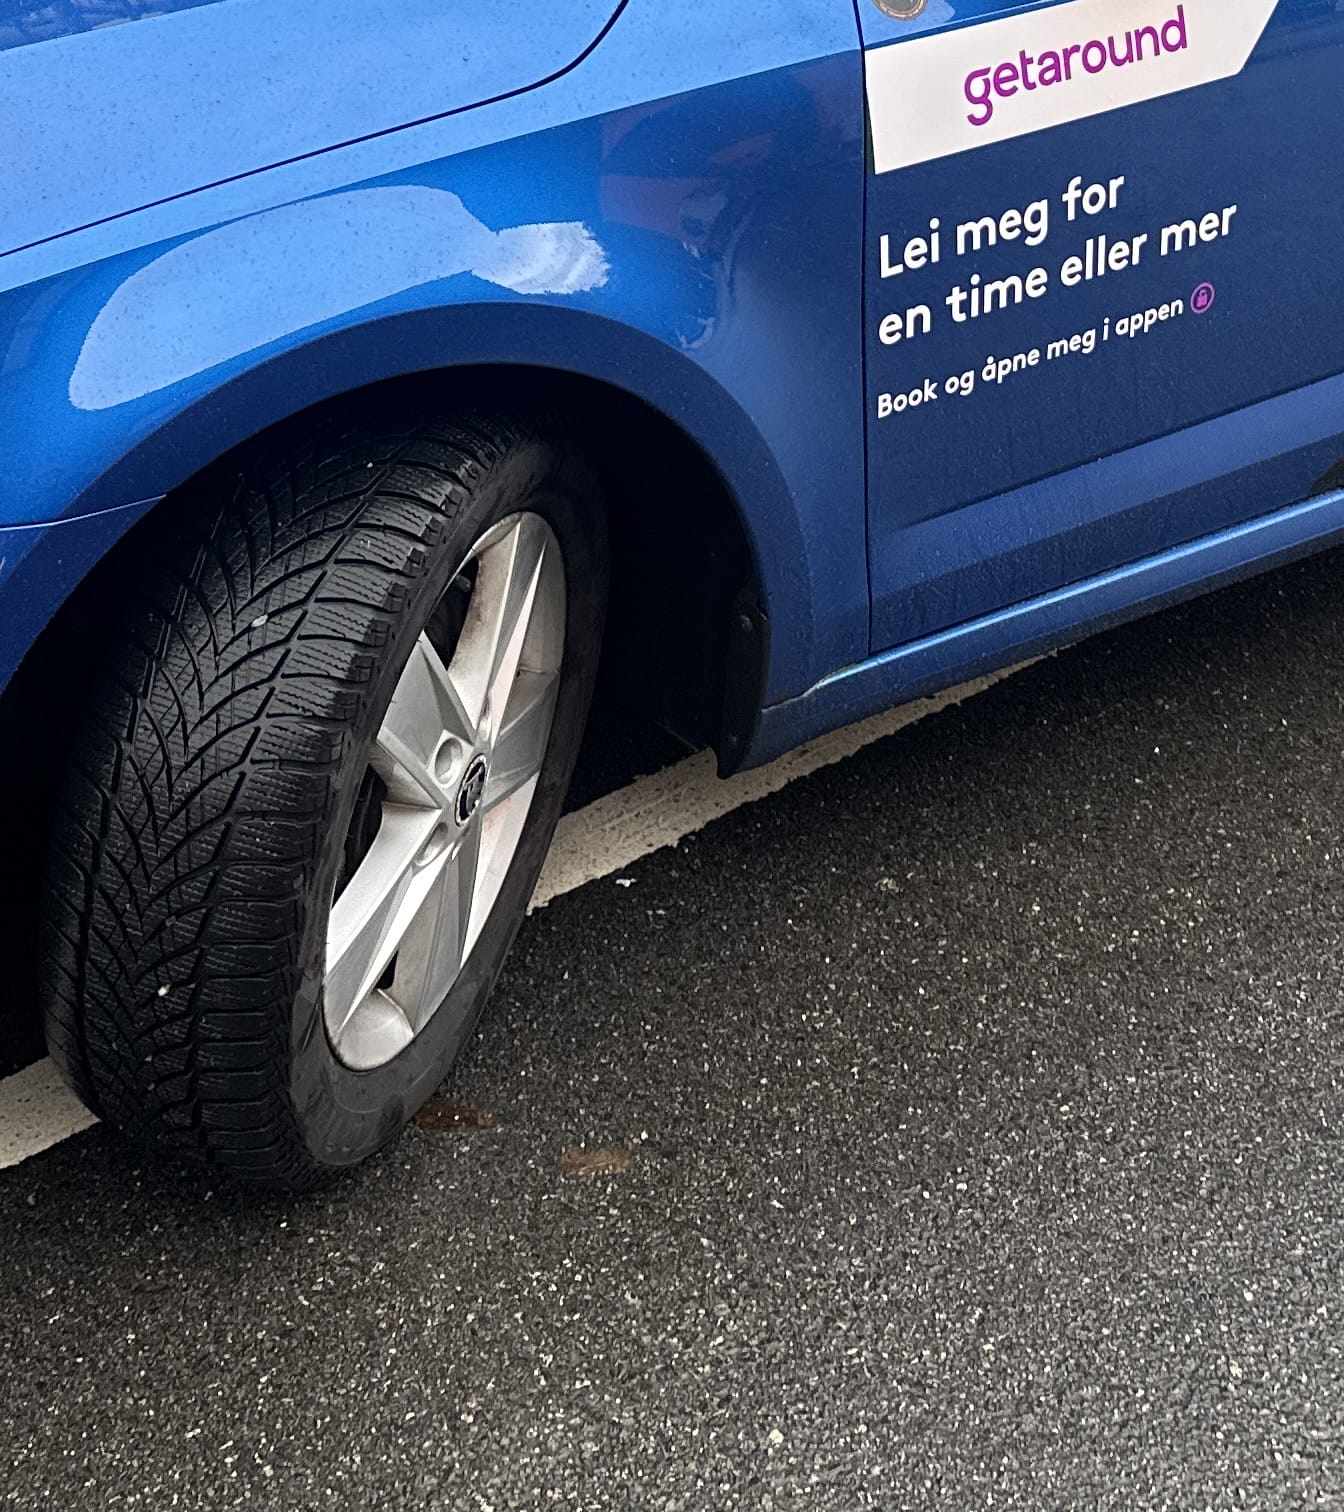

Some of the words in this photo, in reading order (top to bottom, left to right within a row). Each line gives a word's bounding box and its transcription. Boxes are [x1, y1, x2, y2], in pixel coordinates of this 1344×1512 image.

[964, 5, 1188, 126] getaround
[878, 304, 931, 345] en
[945, 267, 1048, 322] time
[1060, 233, 1148, 286] eller
[1160, 204, 1237, 256] mer
[880, 218, 940, 279] Lei
[956, 199, 1048, 255] meg
[1061, 175, 1125, 221] for
[877, 378, 938, 419] Book
[944, 370, 975, 396] og
[981, 348, 1040, 384] åpne
[1046, 328, 1096, 360] meg
[1102, 317, 1110, 341] i
[1115, 299, 1184, 338] appen
